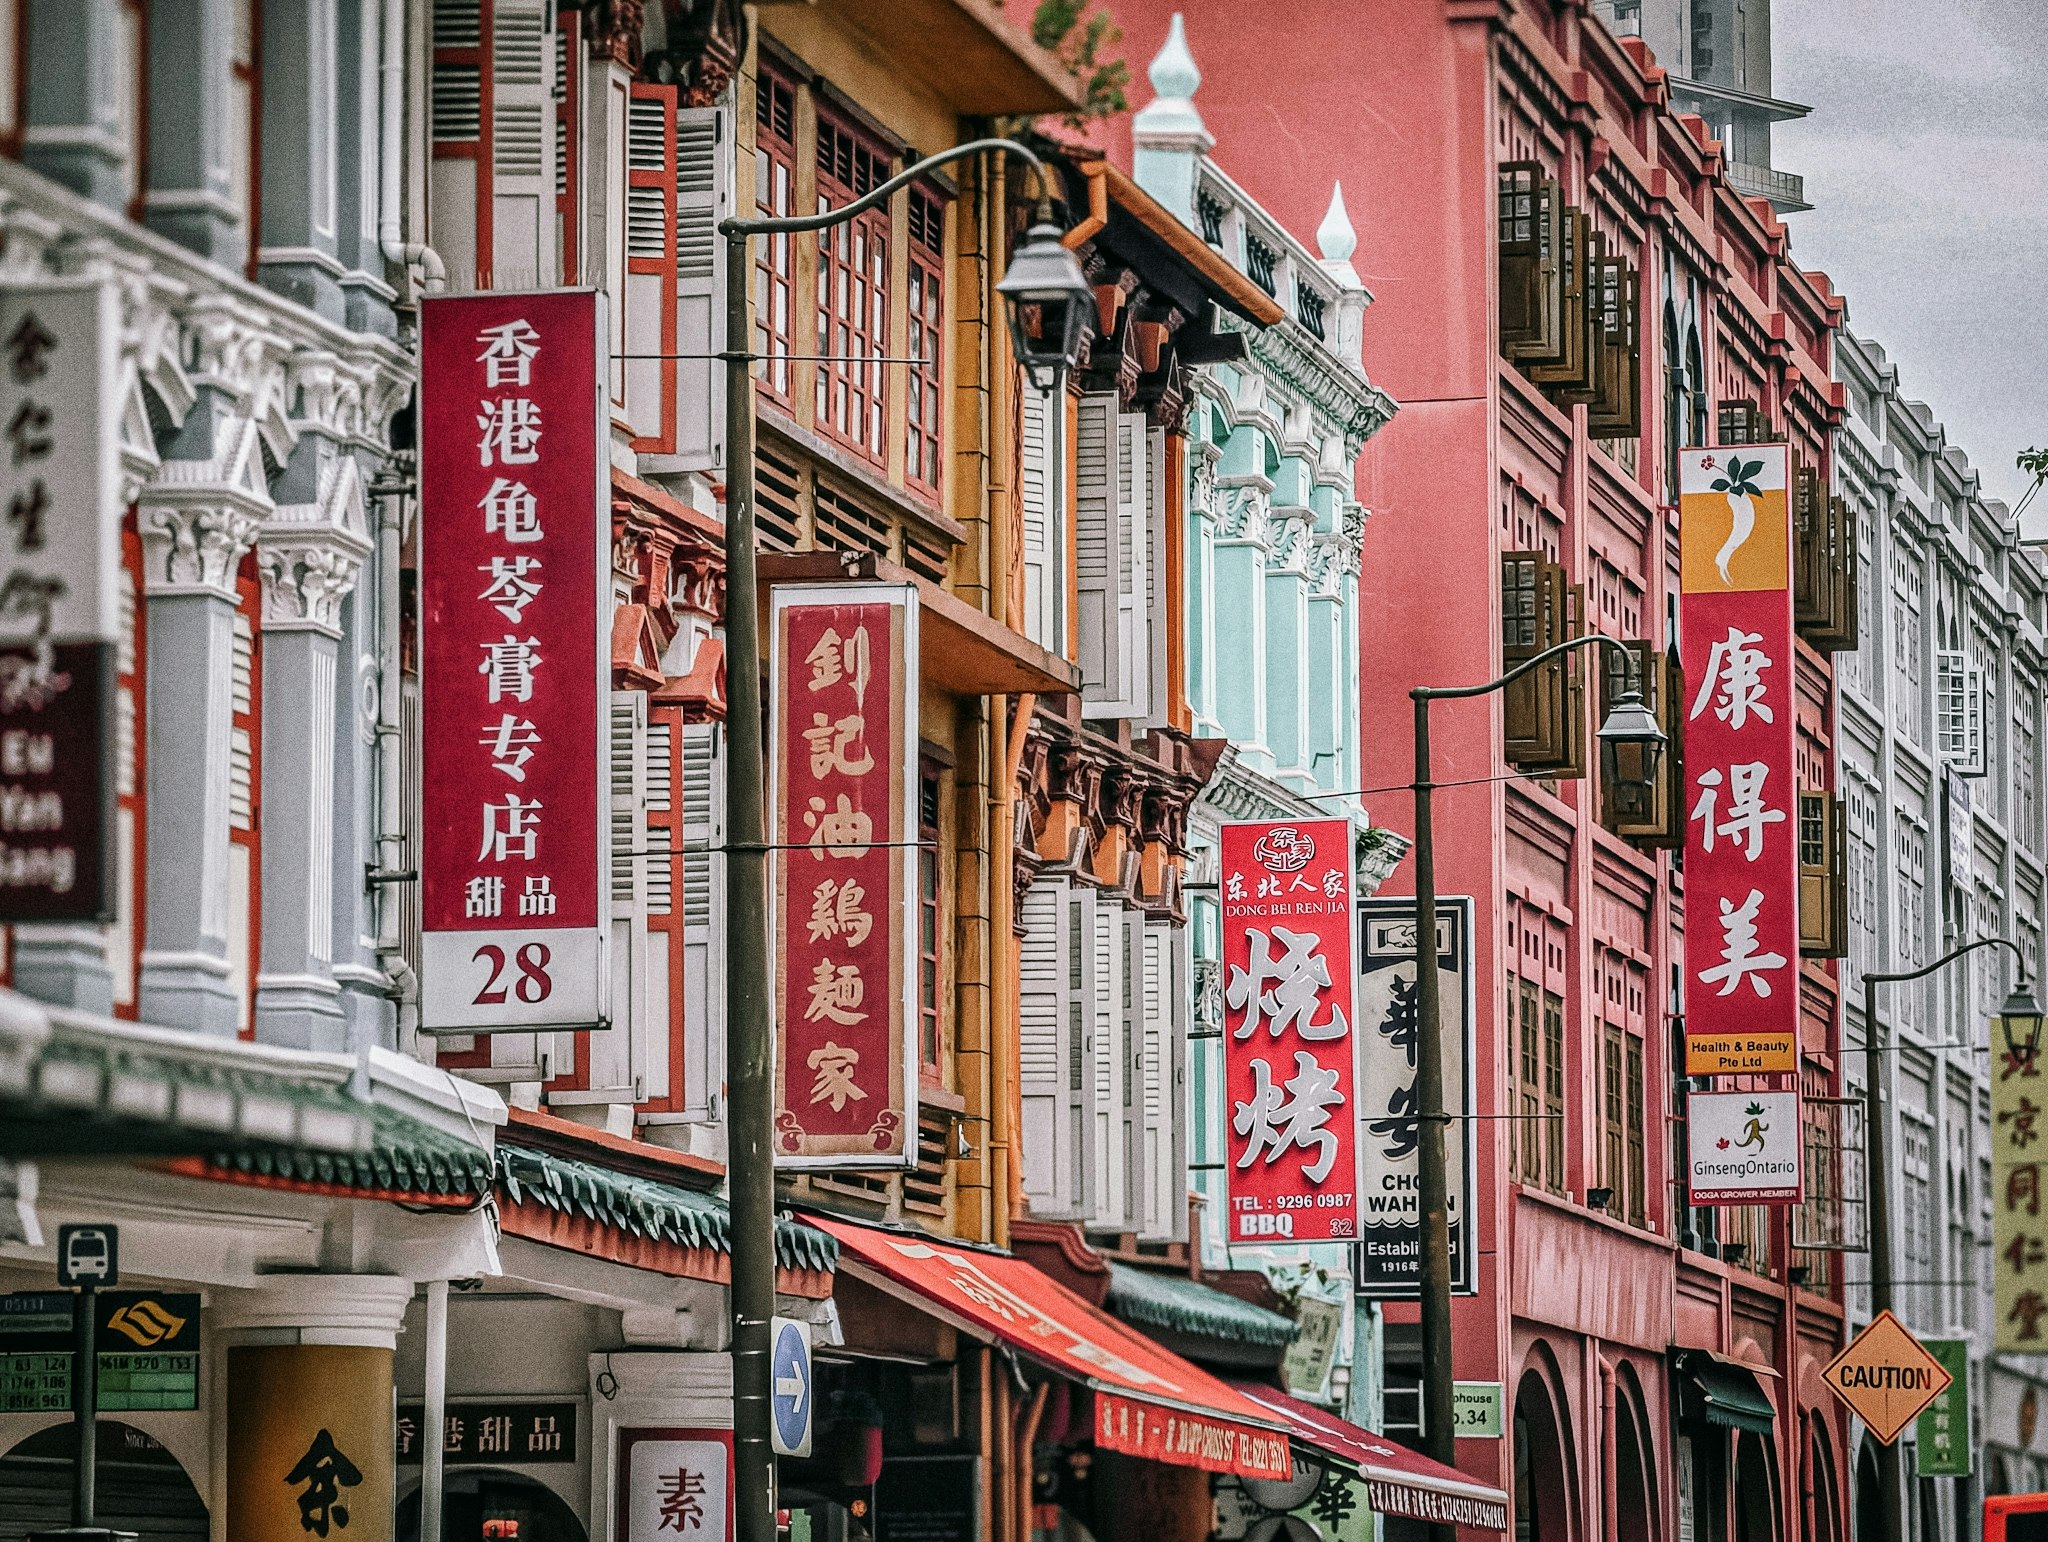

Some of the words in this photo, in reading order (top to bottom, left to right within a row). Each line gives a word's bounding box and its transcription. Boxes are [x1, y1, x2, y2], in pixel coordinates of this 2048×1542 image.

[476, 318, 544, 863] 香港龟苓膏专店
[1689, 626, 1788, 999] 康得美
[1226, 868, 1347, 901] 东北人家
[465, 876, 556, 918] 甜品
[1226, 903, 1267, 917] DONG
[1271, 903, 1292, 915] BEI
[1296, 902, 1323, 914] REN
[1327, 901, 1346, 914] JIA
[471, 942, 552, 1005] 28
[1226, 924, 1349, 1186] 烧烤
[1692, 1042, 1730, 1052] Health
[1734, 1042, 1743, 1052] &
[1747, 1041, 1789, 1053] Beauty
[1719, 1057, 1738, 1067] Pte
[1742, 1057, 1762, 1067] Ltd
[1694, 1160, 1795, 1178] GinsengOntario
[1277, 1195, 1313, 1210] 9296
[1317, 1193, 1352, 1208] 0987
[1721, 1190, 1758, 1199] GROWER
[1760, 1189, 1796, 1198] MEMBER
[1368, 1196, 1417, 1212] WAH
[1240, 1213, 1294, 1238] BBQ
[1330, 1217, 1353, 1236] 32
[1367, 1240, 1457, 1256] Establid
[1381, 1260, 1420, 1273] 1916年
[133, 1356, 159, 1370] 970
[1840, 1365, 1931, 1390] CAUTION
[42, 1393, 66, 1408] 961
[656, 1466, 706, 1533] 素
